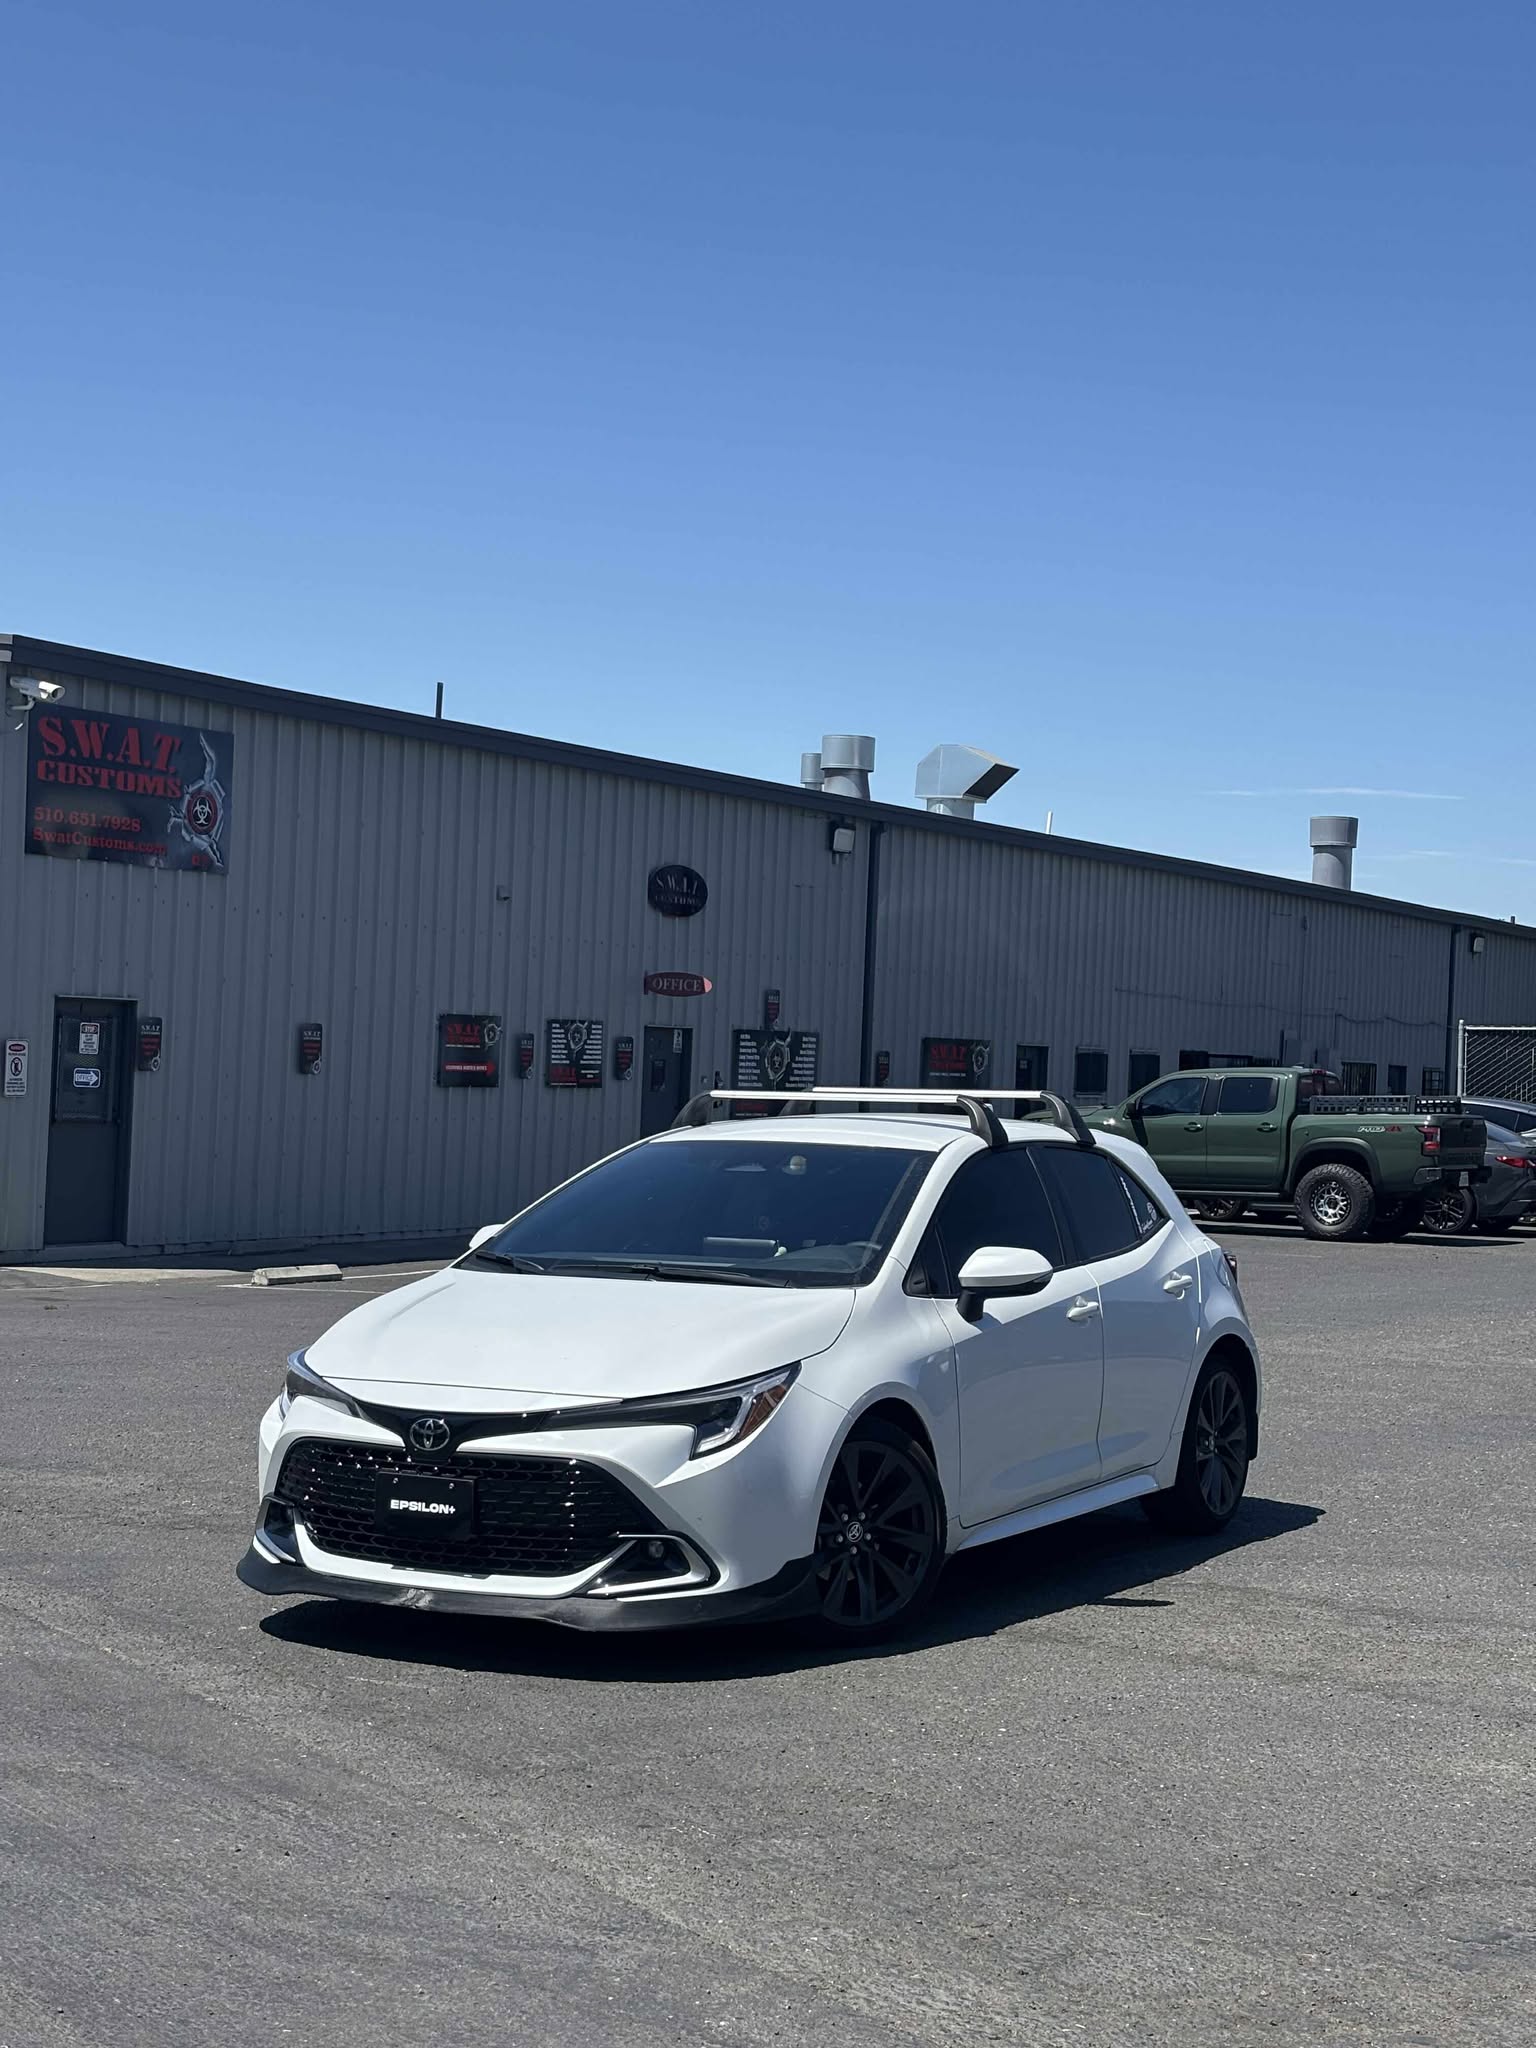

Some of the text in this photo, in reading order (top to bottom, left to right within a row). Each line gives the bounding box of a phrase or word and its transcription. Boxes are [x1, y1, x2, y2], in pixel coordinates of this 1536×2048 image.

[37, 759, 182, 799] CUSTOMS
[34, 806, 142, 832] 510.651.7928
[33, 827, 168, 856] SwatCustoms.com
[652, 977, 701, 993] OFFICE
[390, 1499, 456, 1514] EPSILON+
